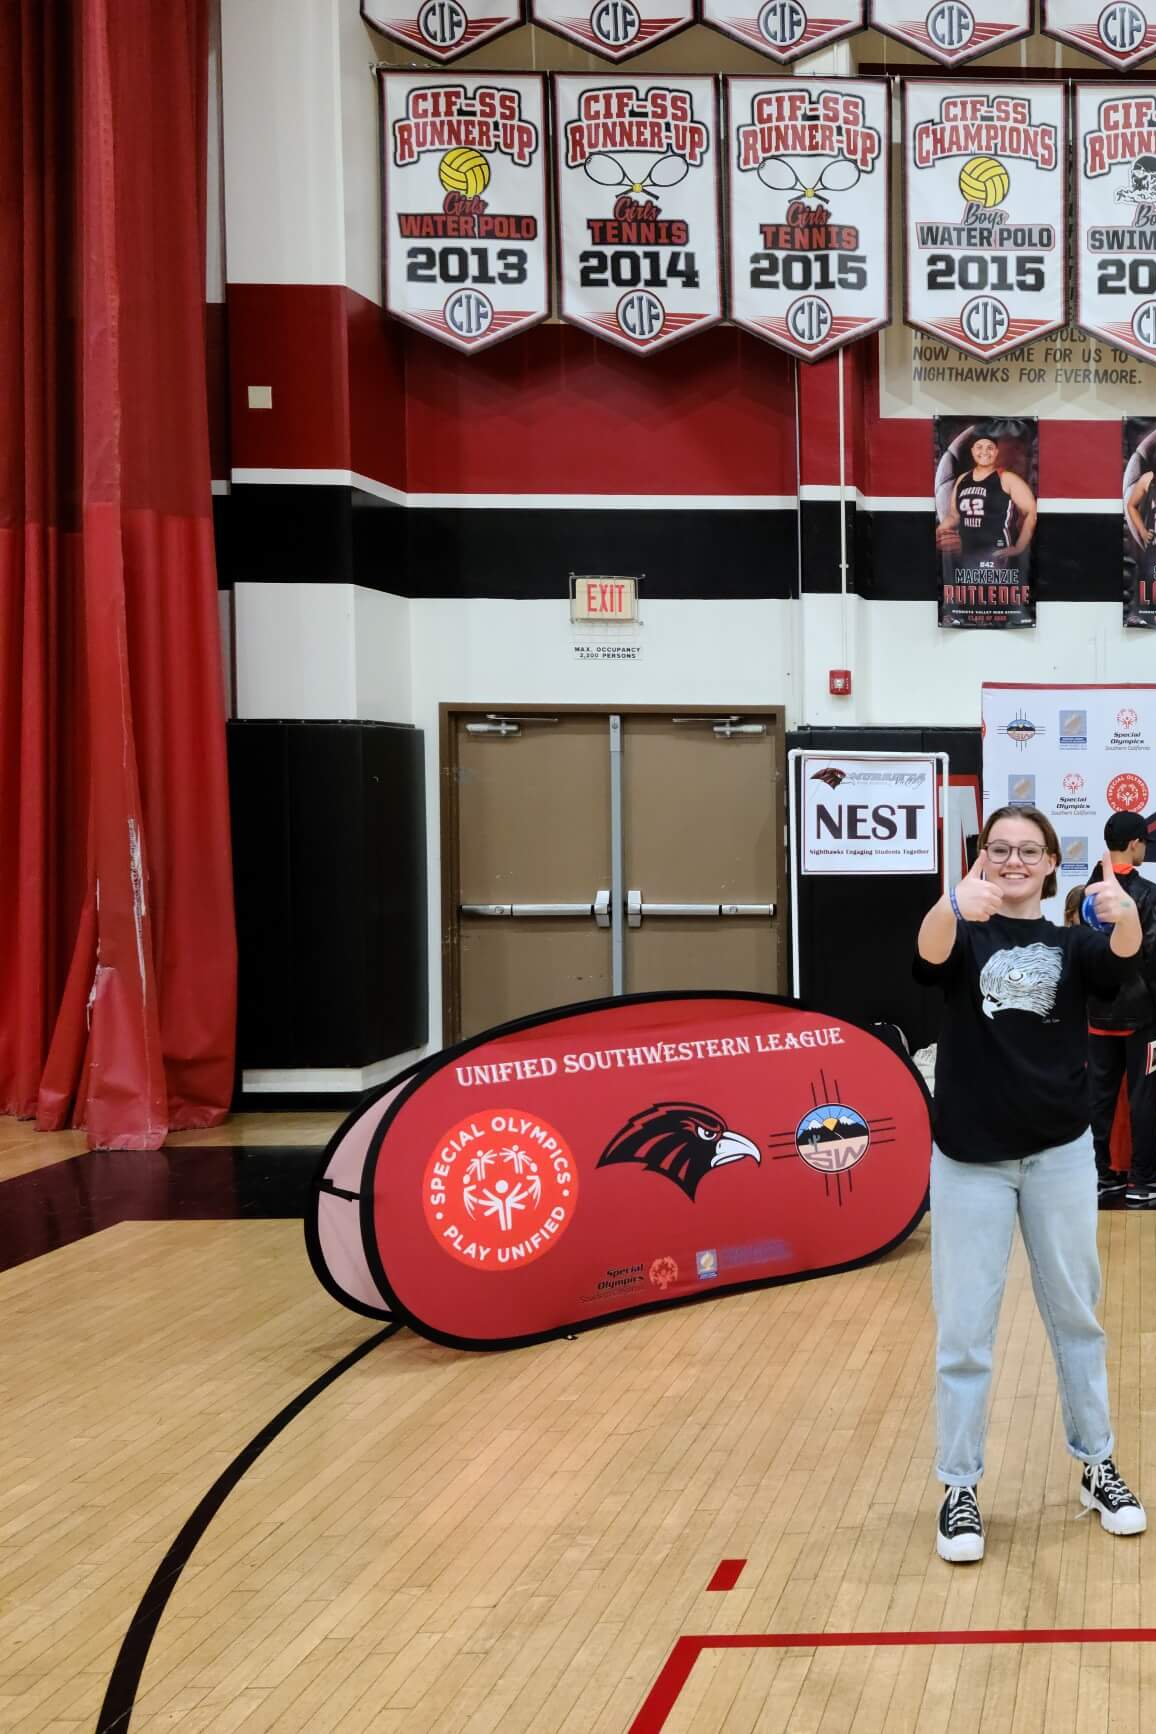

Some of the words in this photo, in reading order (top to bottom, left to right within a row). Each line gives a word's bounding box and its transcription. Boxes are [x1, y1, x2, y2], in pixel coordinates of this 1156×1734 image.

[421, 1, 464, 41] CIF
[595, 1, 637, 41] CIF
[763, 1, 803, 42] CIF
[930, 3, 971, 45] CIF
[1103, 4, 1142, 46] CIF
[411, 90, 519, 120] CIF-SS
[583, 91, 688, 122] CIF-SS
[756, 94, 859, 127] CIF-SS
[943, 98, 1029, 124] CIF-SS
[397, 119, 534, 164] RUNNER-UP
[569, 121, 705, 165] RUNNER-UP
[742, 125, 876, 169] RUNNER-UP
[915, 123, 1055, 168] CHAMPIONS
[443, 192, 487, 215] Girls
[613, 197, 658, 221] Girls
[787, 202, 829, 225] Girls
[963, 203, 1006, 227] Boys
[400, 216, 475, 238] WATER
[480, 216, 536, 238] POLO
[589, 221, 686, 244] TENNIS
[762, 226, 856, 250] TENNIS
[919, 224, 994, 248] WATER
[998, 225, 1053, 248] POLO
[406, 246, 528, 284] 2013
[580, 250, 699, 288] 2014
[750, 252, 867, 290] 2015
[927, 255, 1045, 291] 2015
[449, 293, 489, 334] CIF
[621, 294, 660, 335] CIF
[790, 299, 829, 341] CIF
[964, 300, 1006, 341] CIF
[913, 347, 950, 362] NOW
[1044, 347, 1072, 363] FOR
[1082, 347, 1102, 363] US
[1110, 347, 1129, 364] TO
[912, 366, 1009, 383] NIGHTHAWKS
[1019, 367, 1046, 384] FOR
[1054, 367, 1143, 385] EVERMORE.
[960, 498, 985, 516] 42
[943, 584, 1030, 605] RUTLEDGE
[955, 568, 1020, 584] MACKENZIE
[587, 583, 625, 613] EXIT
[815, 803, 926, 841] NEST
[456, 1057, 558, 1088] UNIFIED
[563, 1034, 753, 1075] SOUTHWESTERN
[756, 1026, 846, 1050] LEAGUE
[430, 1123, 485, 1206] SPECIAL
[491, 1116, 572, 1185] OLYMPICS
[443, 1225, 491, 1261] PLAY
[497, 1205, 566, 1263] UNIFIED
